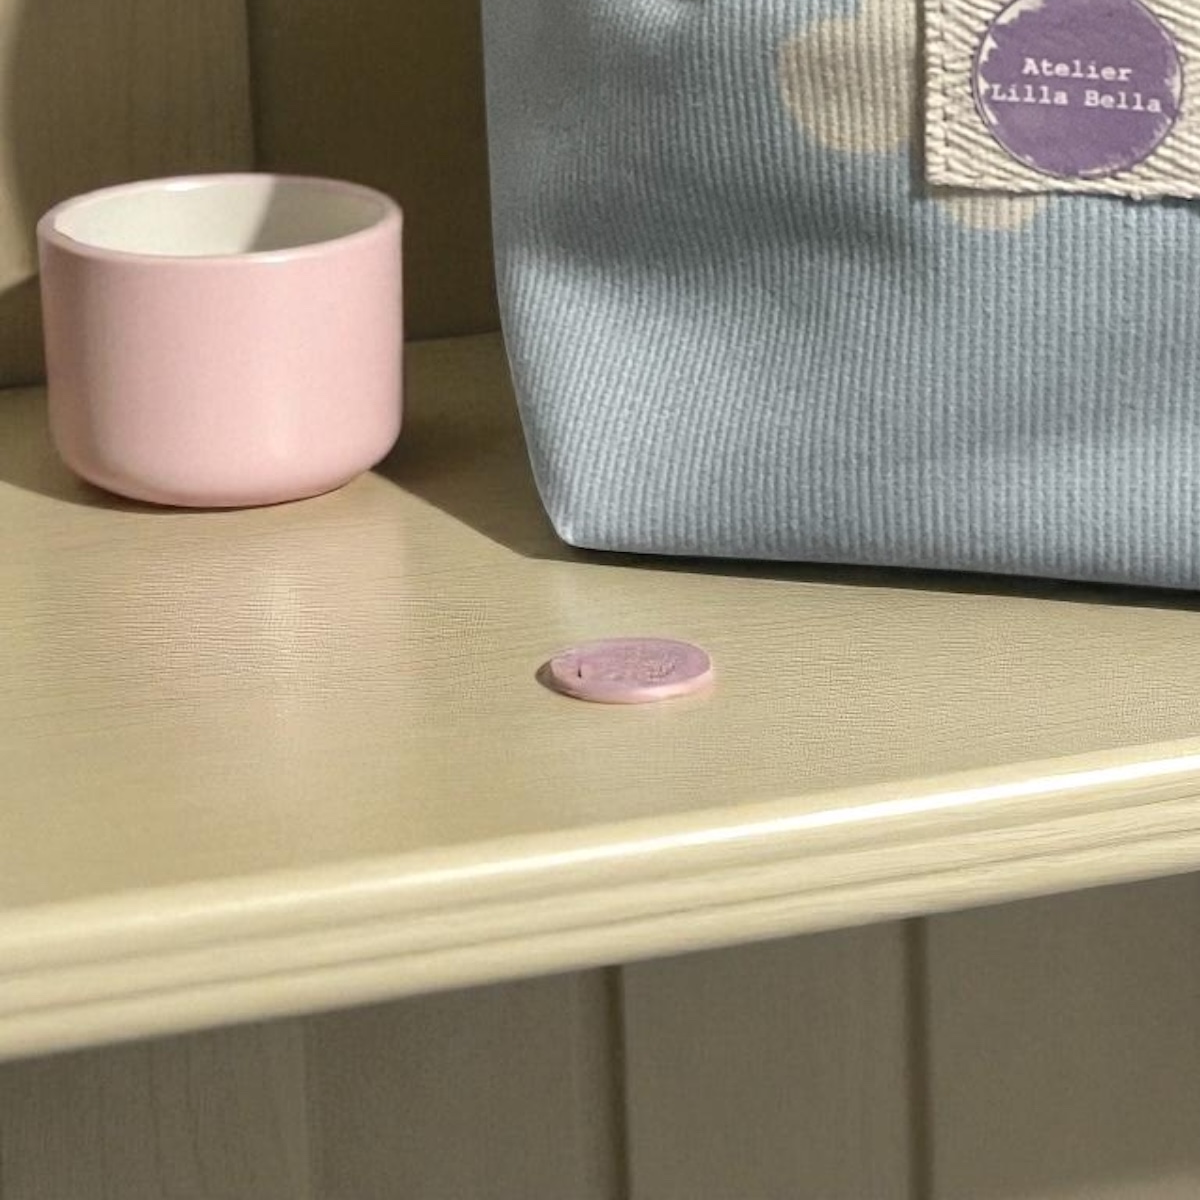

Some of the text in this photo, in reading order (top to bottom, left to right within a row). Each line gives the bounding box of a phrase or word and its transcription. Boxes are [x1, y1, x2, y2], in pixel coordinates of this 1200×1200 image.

[1022, 57, 1132, 81] Atelier
[991, 84, 1162, 113] Lilla Bella
